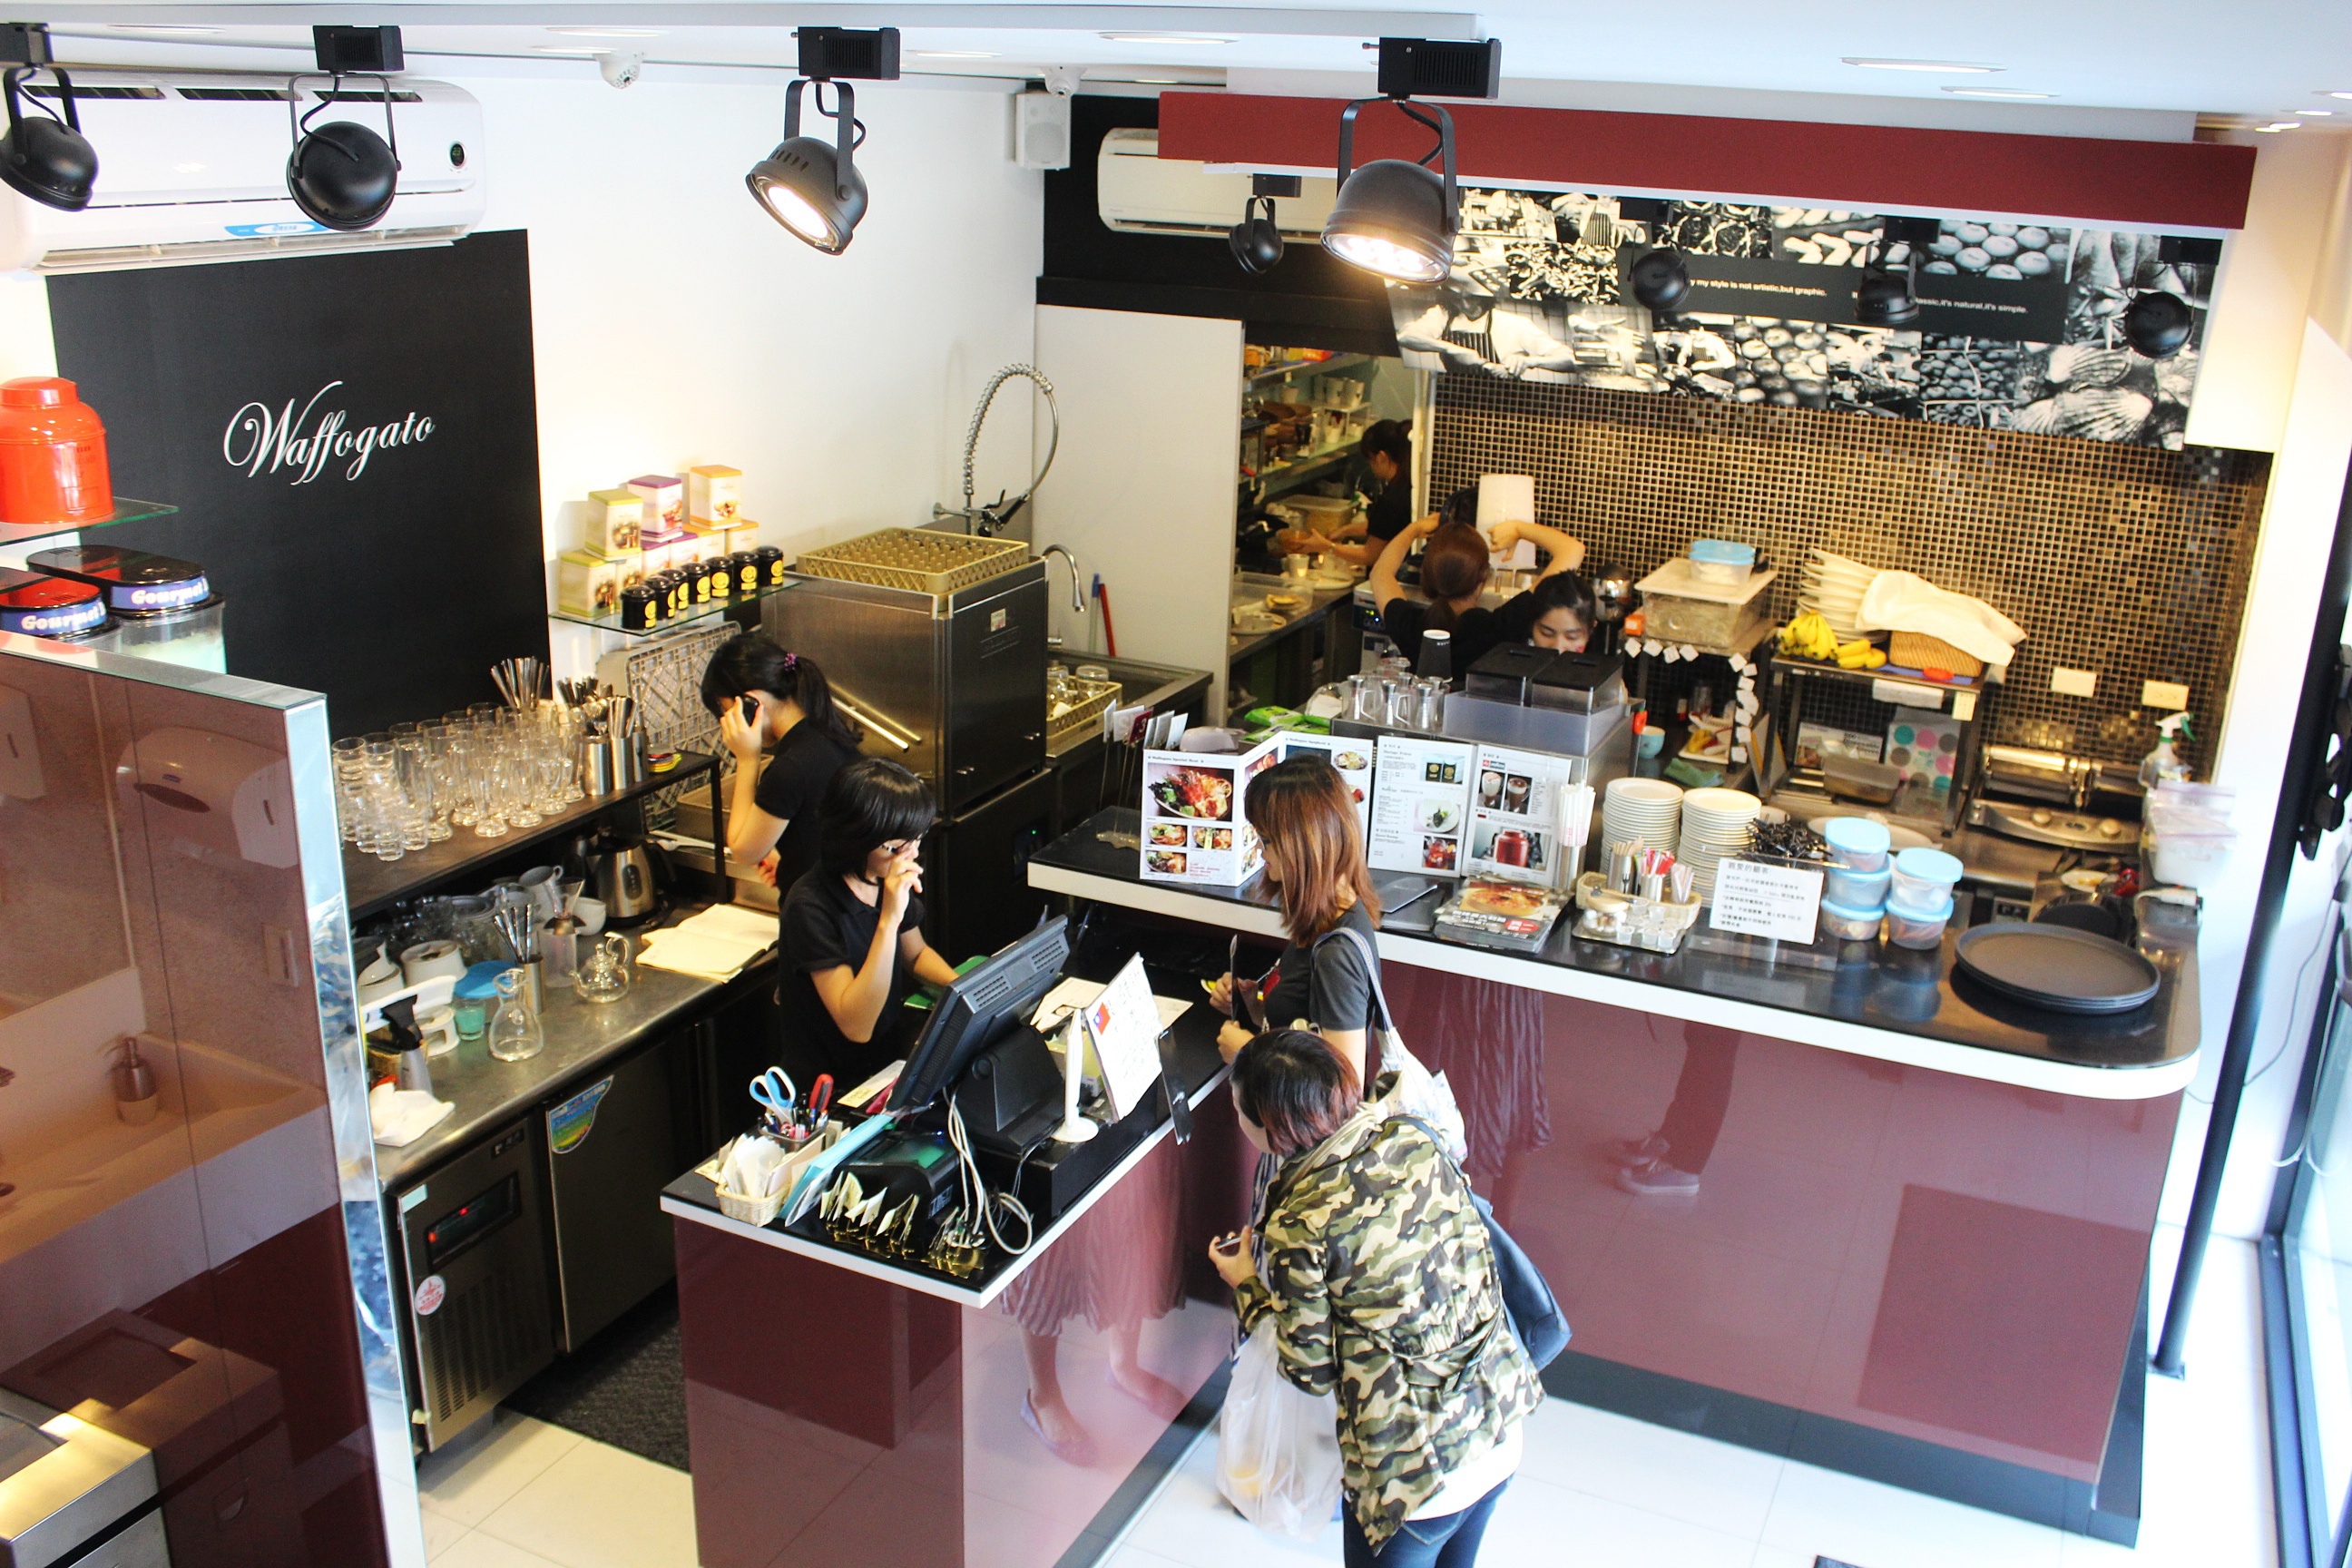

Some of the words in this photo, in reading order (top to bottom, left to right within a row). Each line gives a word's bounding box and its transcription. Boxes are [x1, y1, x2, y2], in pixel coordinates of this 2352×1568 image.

[1696, 279, 1709, 288] my
[1710, 279, 1729, 289] style
[1916, 297, 1953, 308] lassic,it's
[222, 380, 436, 486] Waffogato
[131, 583, 202, 605] Gourmet
[21, 606, 98, 631] Gourmet
